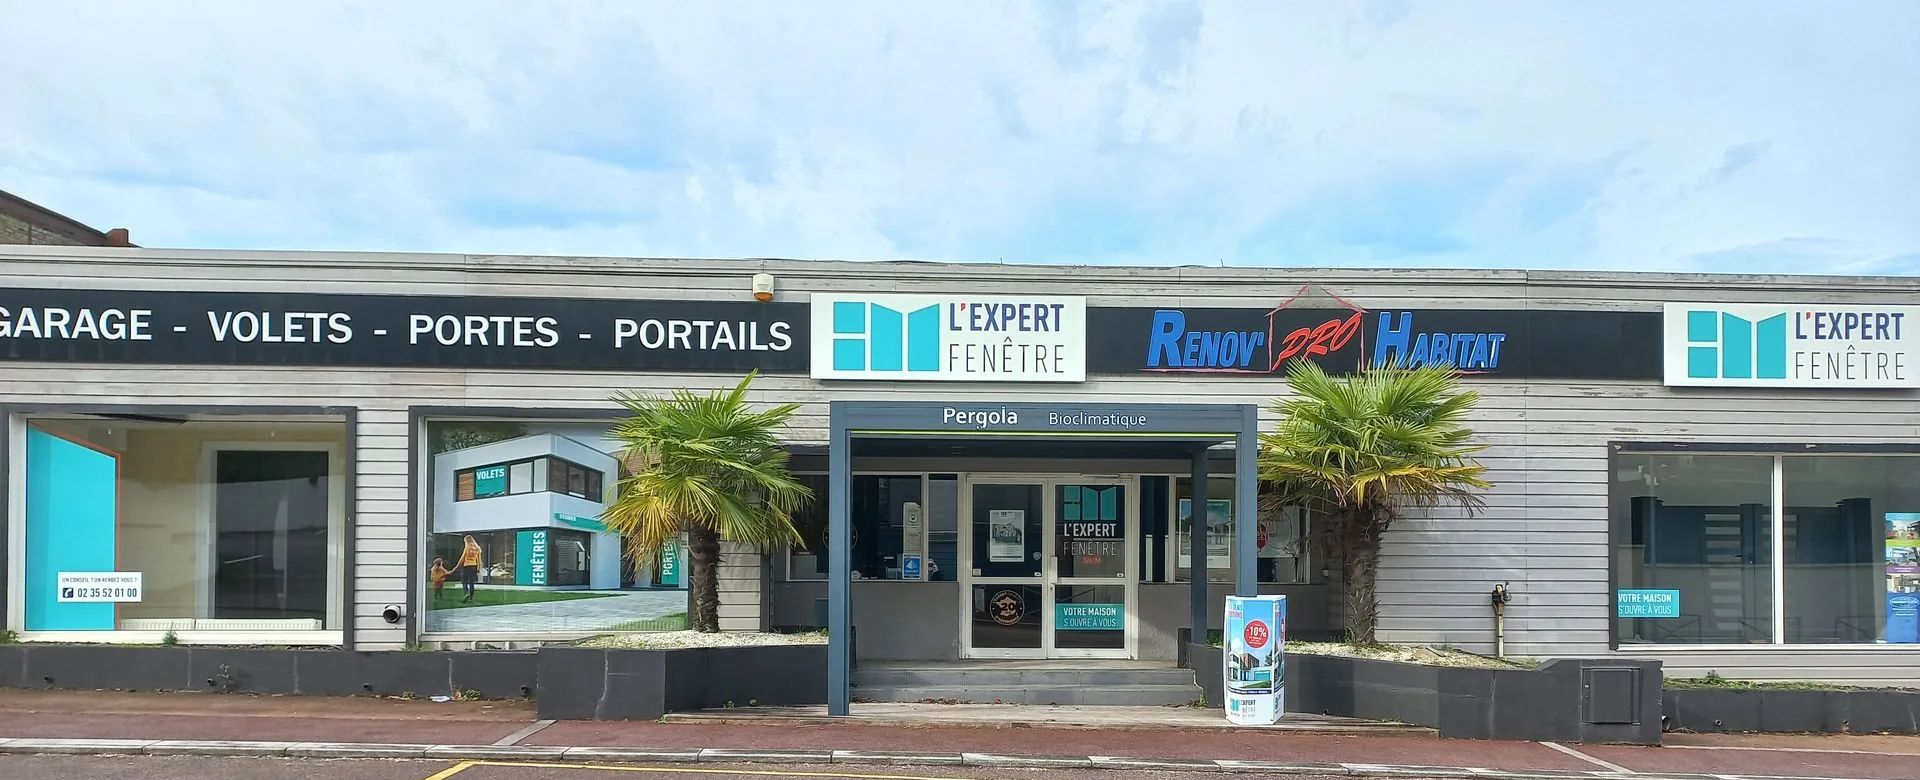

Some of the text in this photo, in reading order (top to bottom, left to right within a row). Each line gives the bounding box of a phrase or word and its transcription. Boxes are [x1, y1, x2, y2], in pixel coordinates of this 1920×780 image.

[949, 302, 1064, 332] L'EXPERT
[0, 306, 152, 341] GARAGE
[207, 310, 353, 343] VOLETS
[409, 314, 559, 347] PORTES
[613, 318, 792, 352] PORTAILS
[1795, 311, 1904, 340] L'EXPERT
[1272, 311, 1362, 371] PRO
[948, 336, 1065, 373] FENÊTRE
[1795, 344, 1905, 380] FENÊTRE
[942, 405, 1147, 429] Pergola Bioclimatique
[476, 467, 505, 480] VOLETS
[1063, 523, 1117, 537] L'EXPERT
[1063, 539, 1117, 556] FENÊTRE
[530, 531, 545, 584] FENÊTRES
[77, 588, 137, 597] 02 35 52 01 00
[1618, 594, 1672, 603] VOTRE MAISON
[1000, 602, 1015, 611] 20
[1063, 607, 1117, 616] VOTRE MAISON
[1618, 604, 1672, 615] S'OUVRE À VOUS
[1063, 617, 1117, 627] S'OUVRE À VOUS
[1246, 626, 1267, 638] -10%
